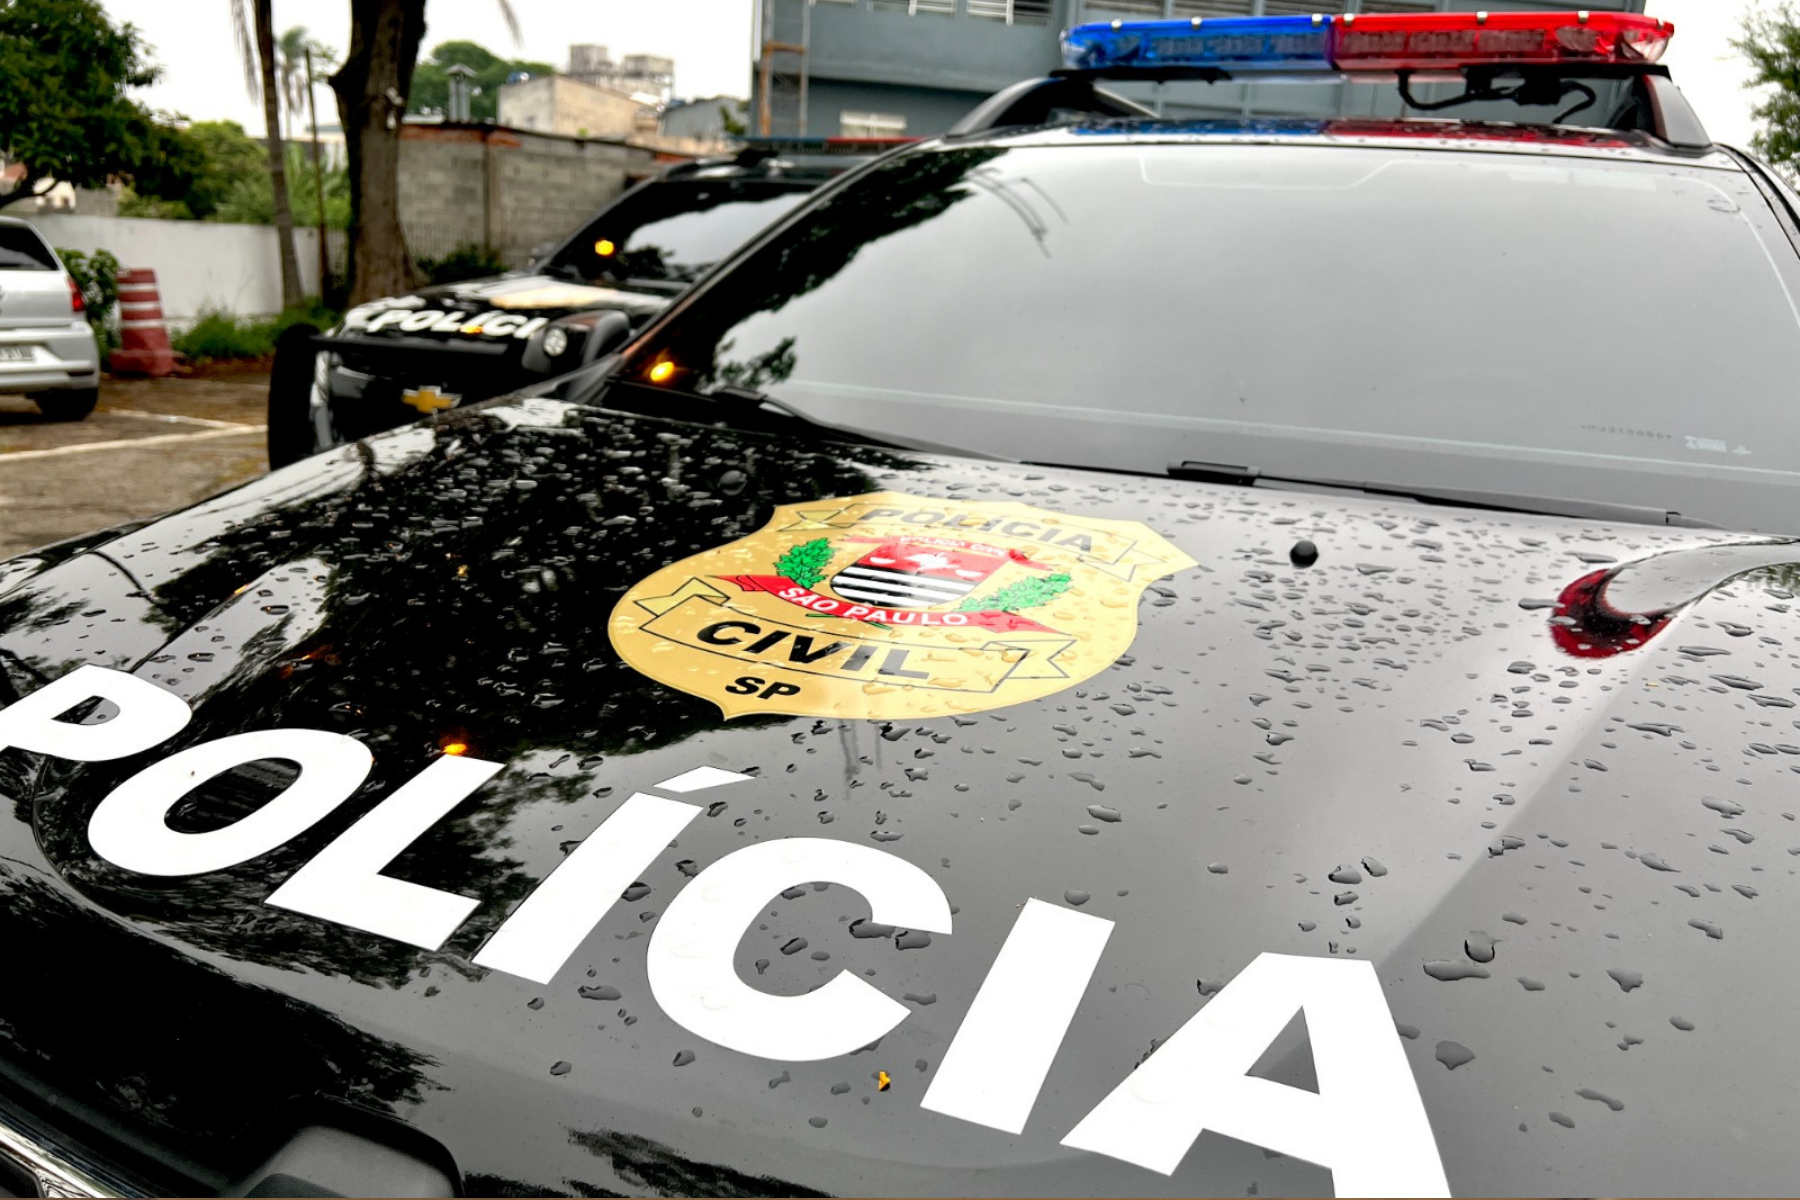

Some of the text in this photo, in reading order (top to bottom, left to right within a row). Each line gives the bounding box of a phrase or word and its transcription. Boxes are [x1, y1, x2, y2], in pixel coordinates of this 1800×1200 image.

[366, 309, 550, 339] POLÍCI
[842, 604, 969, 626] PAULO
[697, 621, 930, 680] CIVIL
[725, 677, 801, 700] SP
[0, 663, 1451, 1198] POLÍCIA
